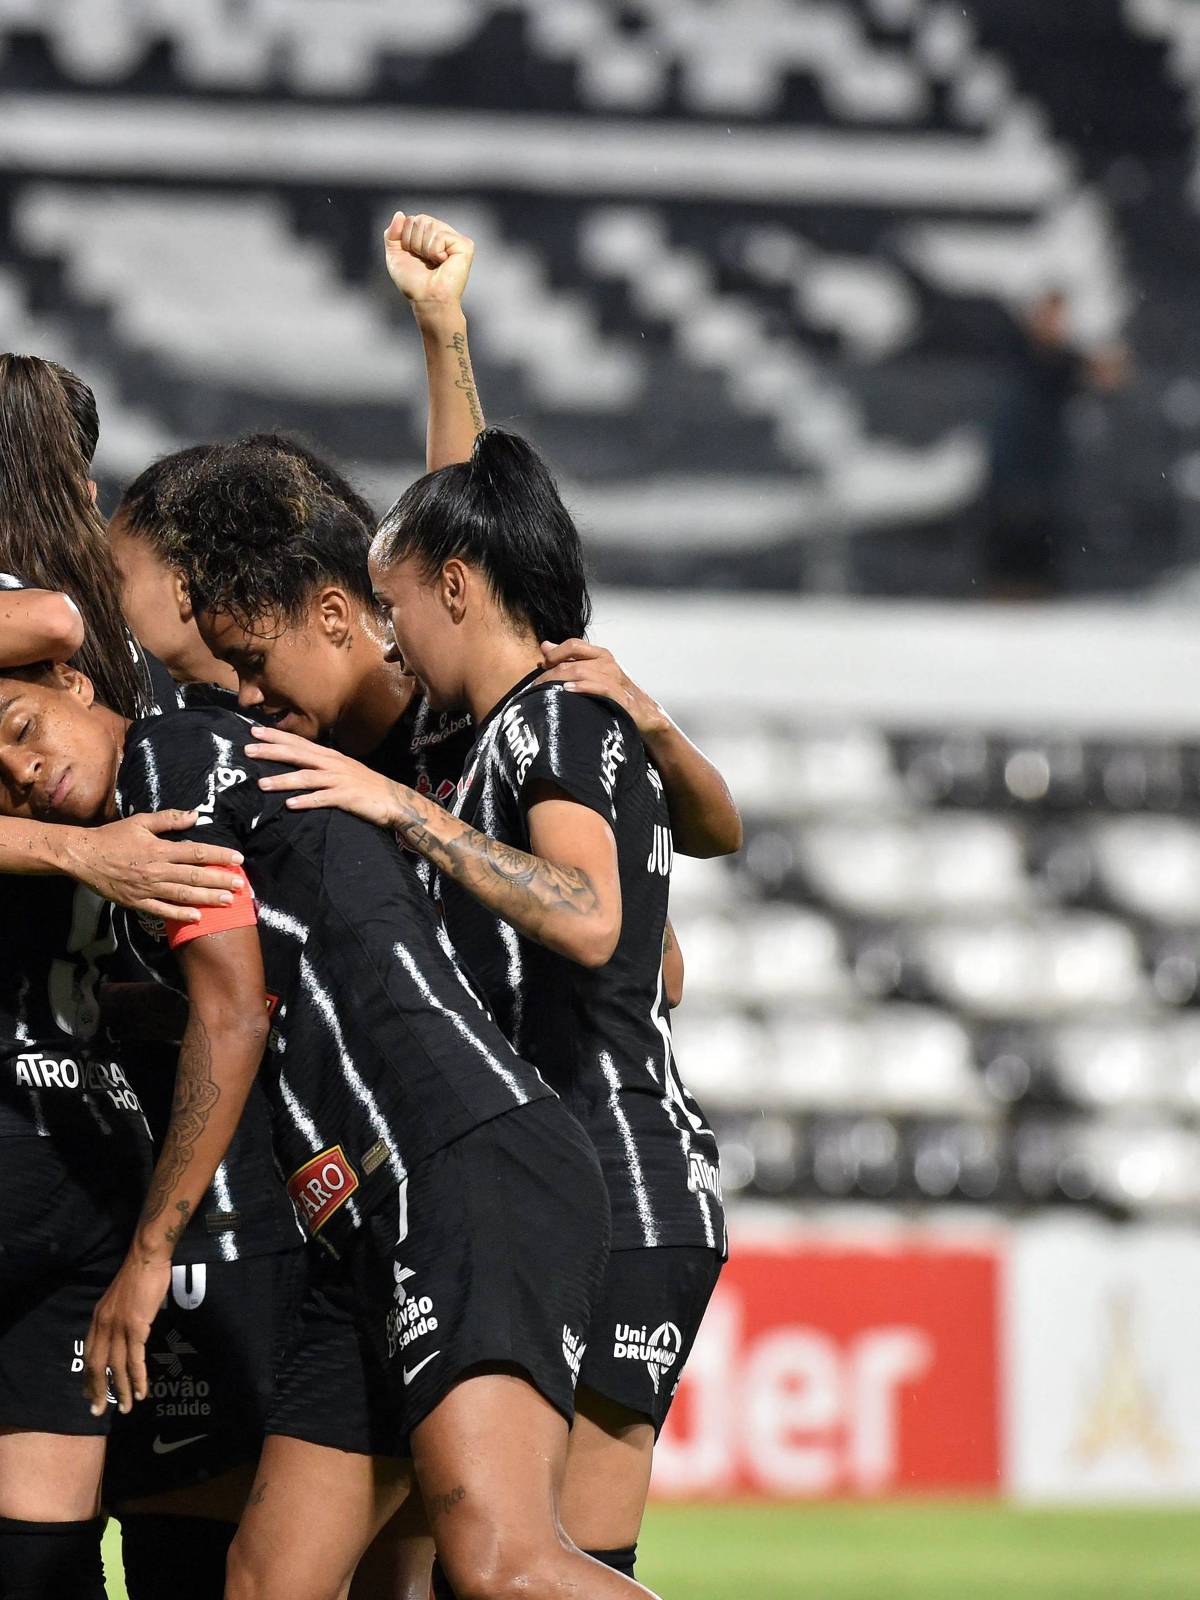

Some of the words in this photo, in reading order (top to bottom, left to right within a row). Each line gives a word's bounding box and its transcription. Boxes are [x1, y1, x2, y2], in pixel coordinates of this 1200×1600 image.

[16, 1053, 134, 1091] ATROVERA
[107, 1089, 143, 1112] HO
[298, 1163, 345, 1226] ARO
[399, 1317, 438, 1350] saúde
[614, 1323, 648, 1344] Uni
[156, 1400, 211, 1417] saúde
